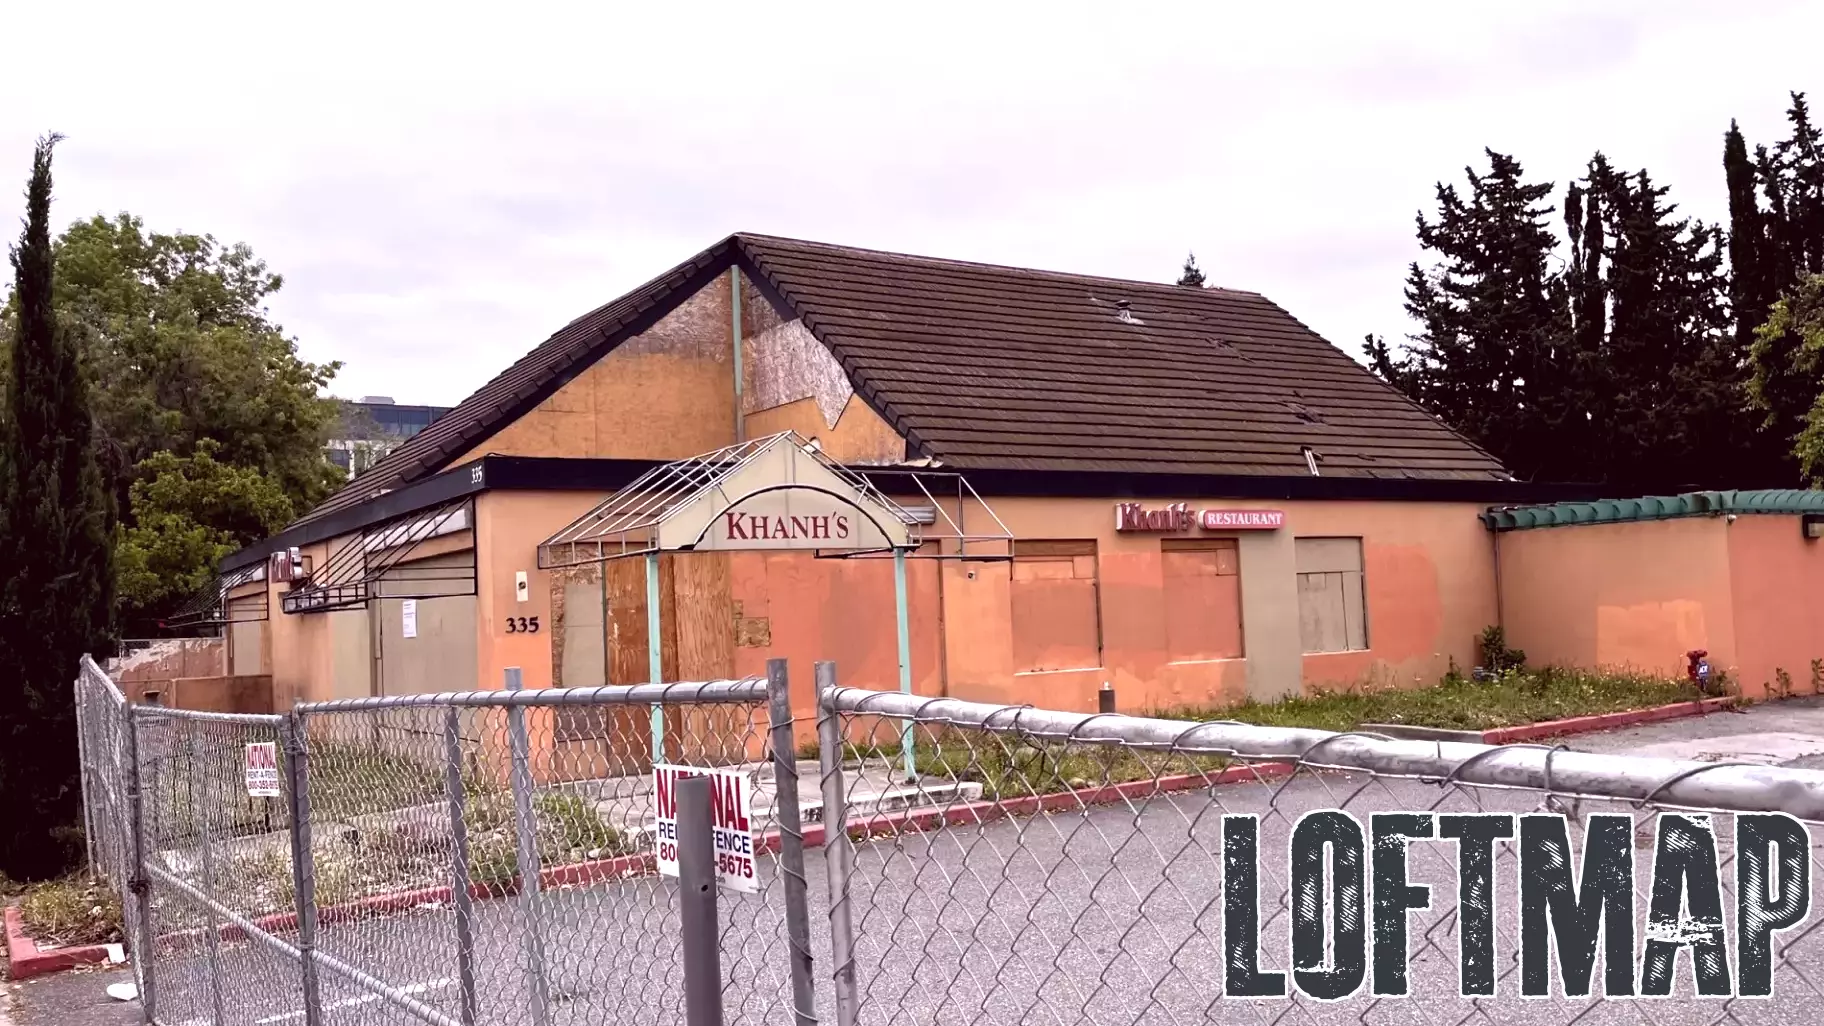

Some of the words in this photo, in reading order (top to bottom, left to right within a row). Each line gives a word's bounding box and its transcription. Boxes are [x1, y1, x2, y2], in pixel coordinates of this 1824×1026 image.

[726, 511, 849, 540] KHANH'S
[1116, 502, 1196, 531] Khanh's
[1207, 512, 1284, 525] RESTAURANT
[505, 616, 540, 634] 335
[246, 744, 276, 769] NATIONAL
[656, 768, 749, 832] NANAL
